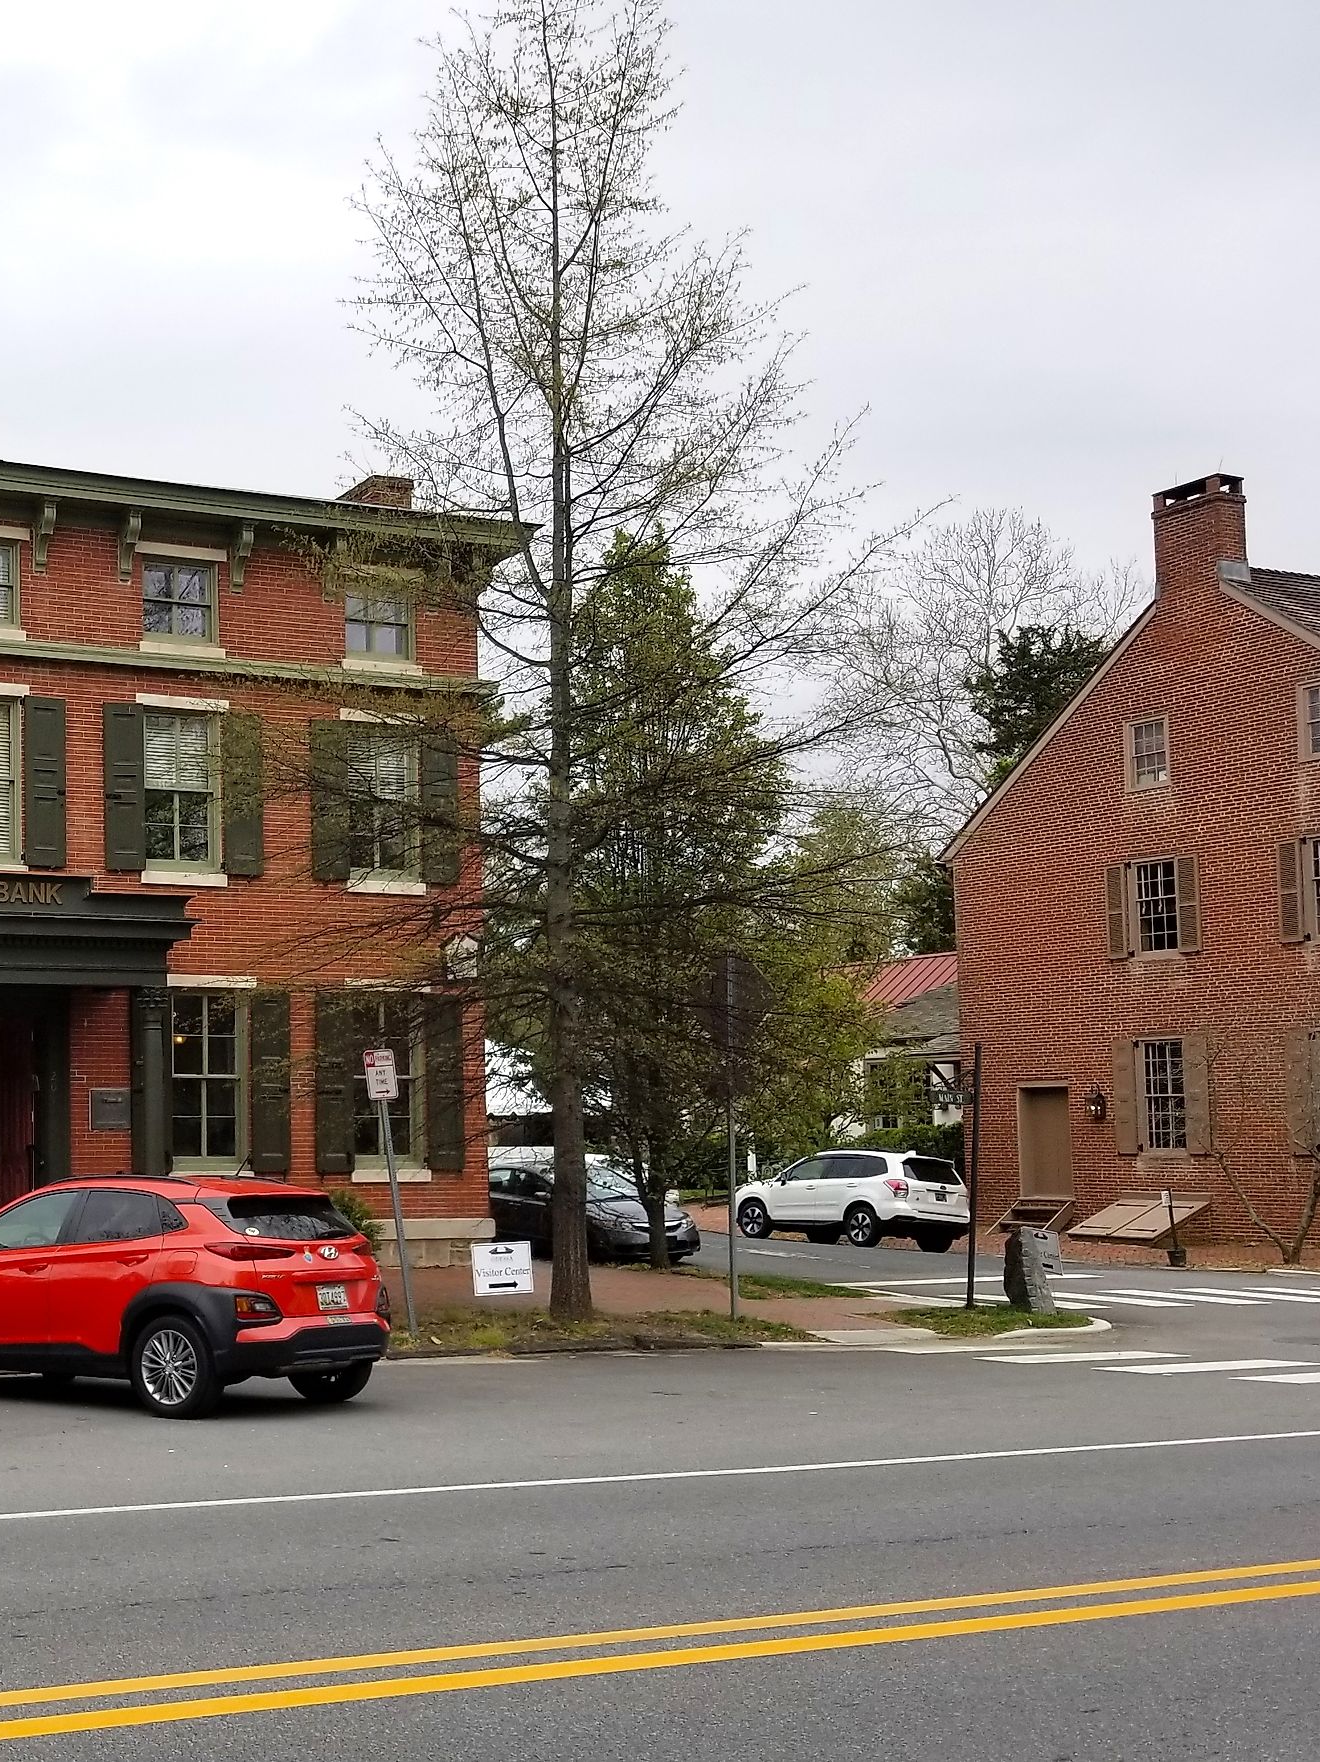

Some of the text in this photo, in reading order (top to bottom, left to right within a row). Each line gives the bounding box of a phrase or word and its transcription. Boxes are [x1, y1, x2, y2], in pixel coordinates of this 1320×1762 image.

[365, 1054, 374, 1065] NO
[938, 1093, 964, 1103] MAIN ST
[475, 1267, 531, 1278] Visitor Center
